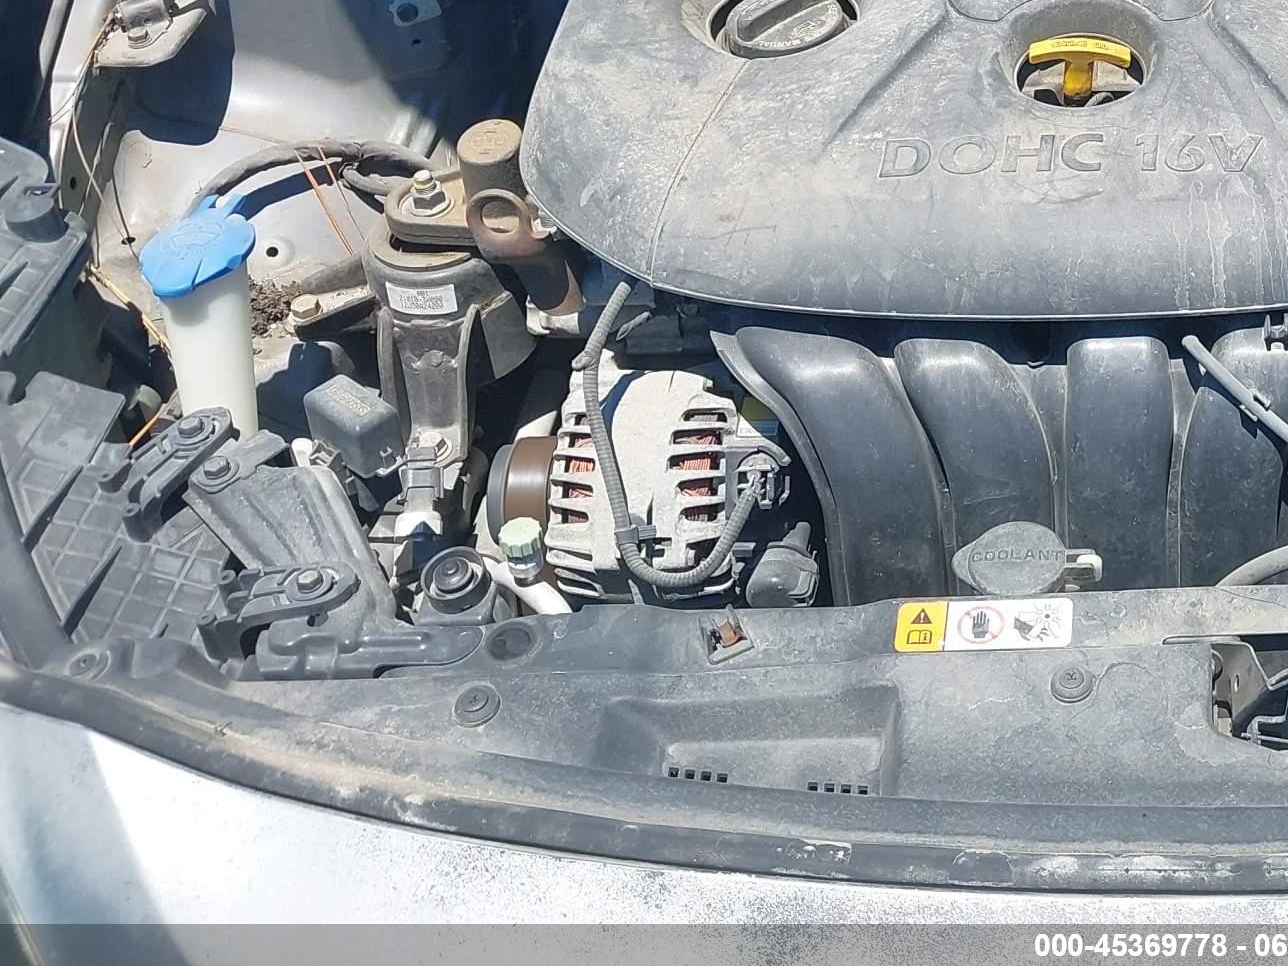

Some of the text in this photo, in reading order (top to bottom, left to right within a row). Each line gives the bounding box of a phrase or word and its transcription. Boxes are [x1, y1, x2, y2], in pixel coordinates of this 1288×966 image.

[879, 133, 1264, 178] DOHC 16V
[971, 548, 1063, 563] COOLANT
